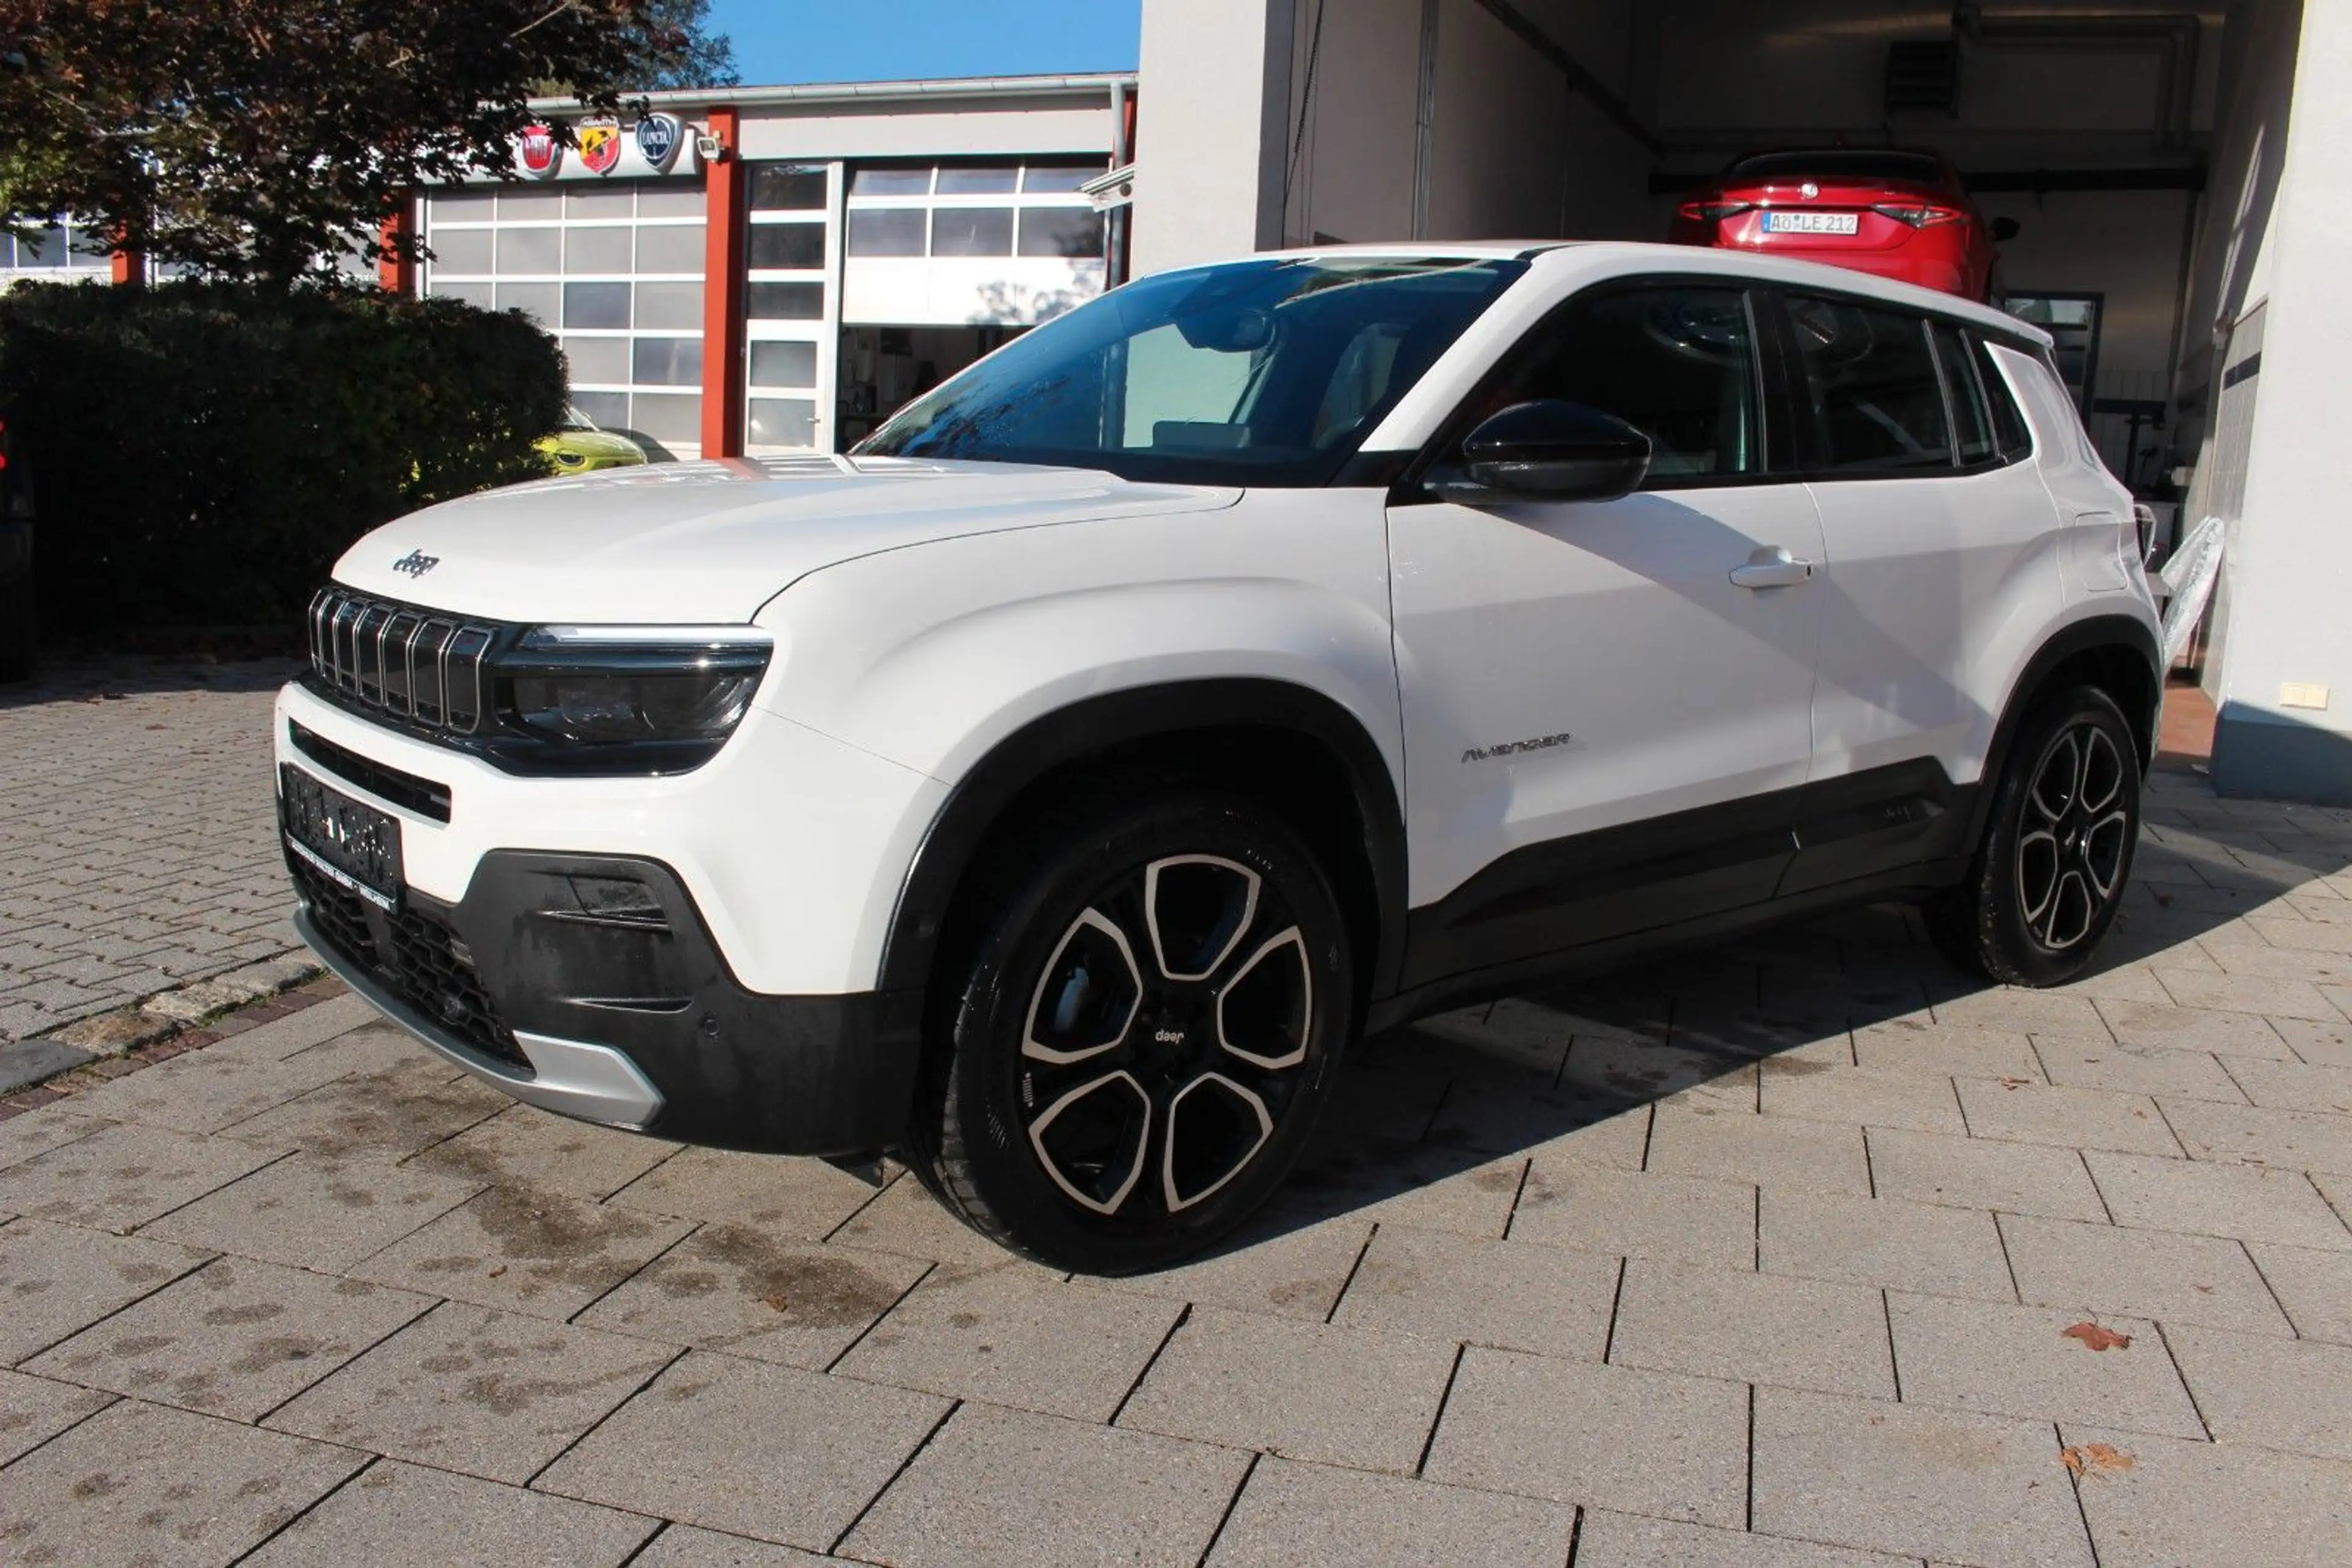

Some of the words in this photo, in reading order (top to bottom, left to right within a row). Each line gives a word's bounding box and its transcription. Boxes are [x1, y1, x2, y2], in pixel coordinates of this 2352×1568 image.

[642, 131, 669, 145] LANCIA
[1802, 216, 1822, 231] LE
[1825, 216, 1855, 232] 212
[393, 549, 440, 579] Jeep
[1461, 733, 1570, 763] AVENGER
